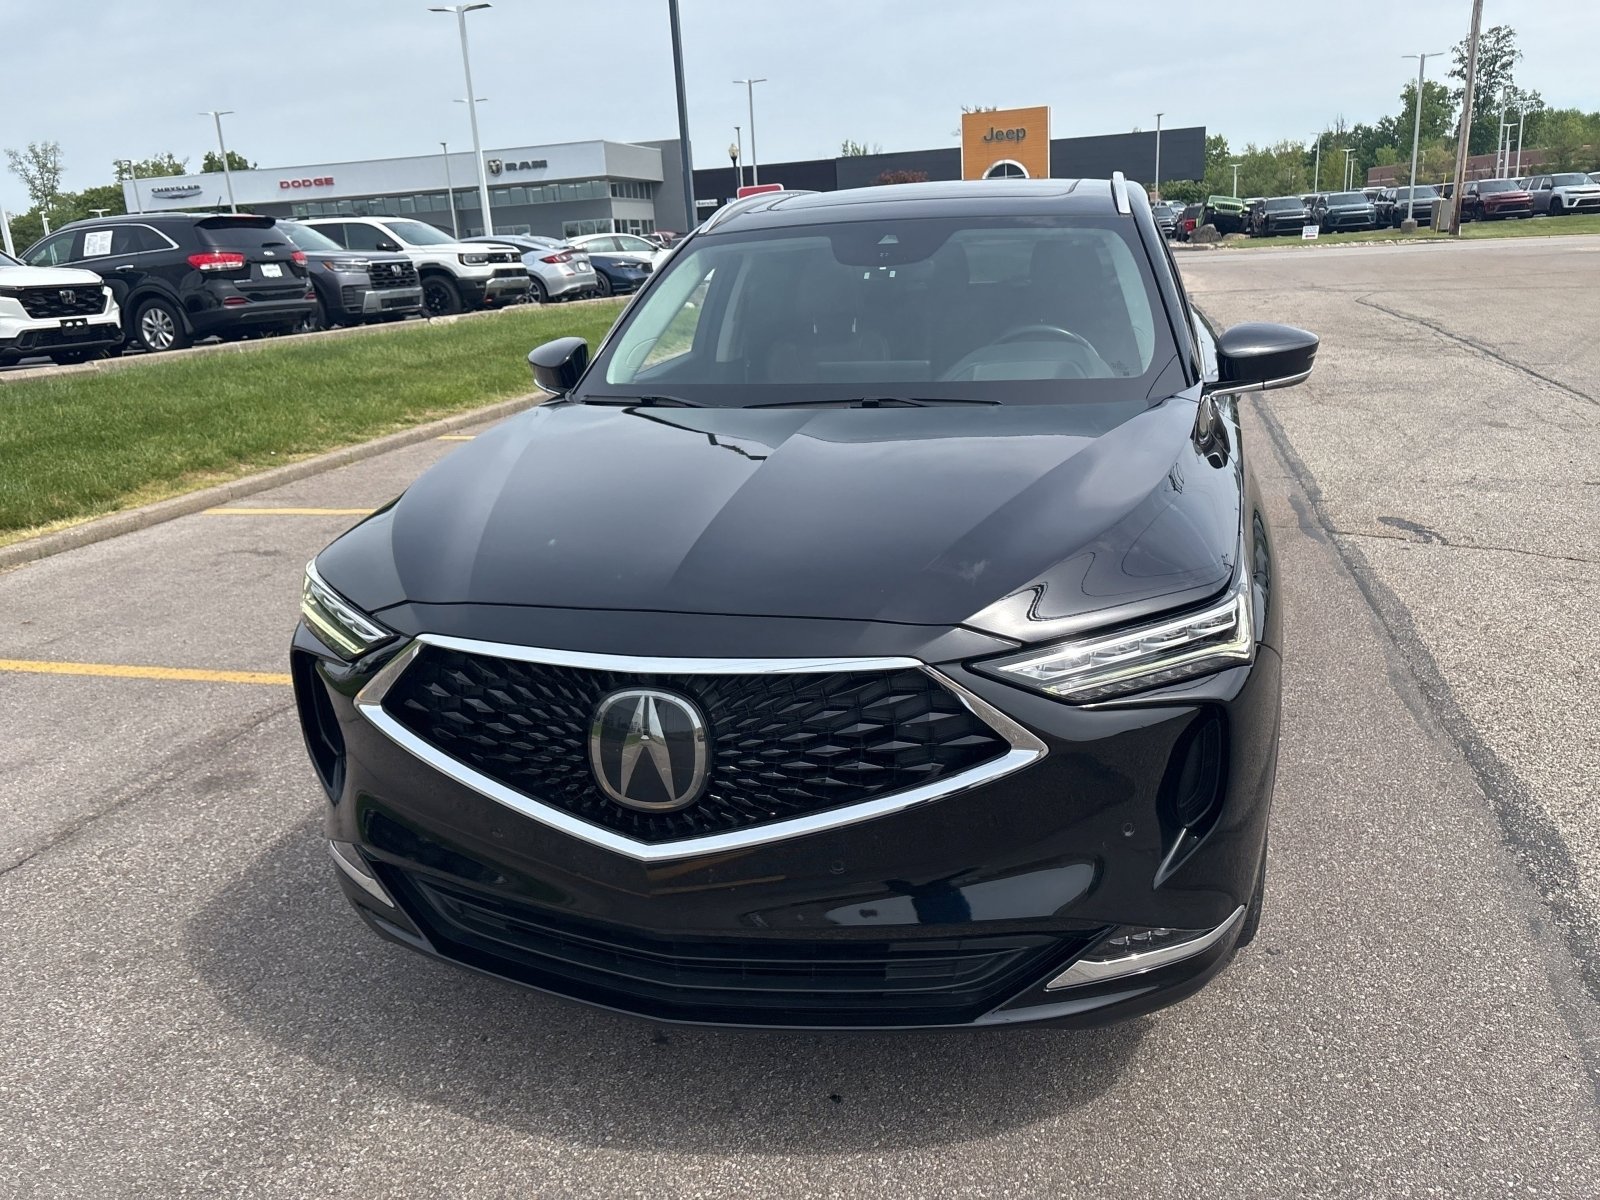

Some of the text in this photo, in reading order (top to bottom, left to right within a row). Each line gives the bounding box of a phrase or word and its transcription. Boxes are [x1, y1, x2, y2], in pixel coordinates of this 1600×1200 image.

[983, 127, 1026, 143] Jeep
[505, 160, 548, 171] RAM
[280, 177, 334, 189] DODGE
[151, 185, 201, 193] CHRYSLER
